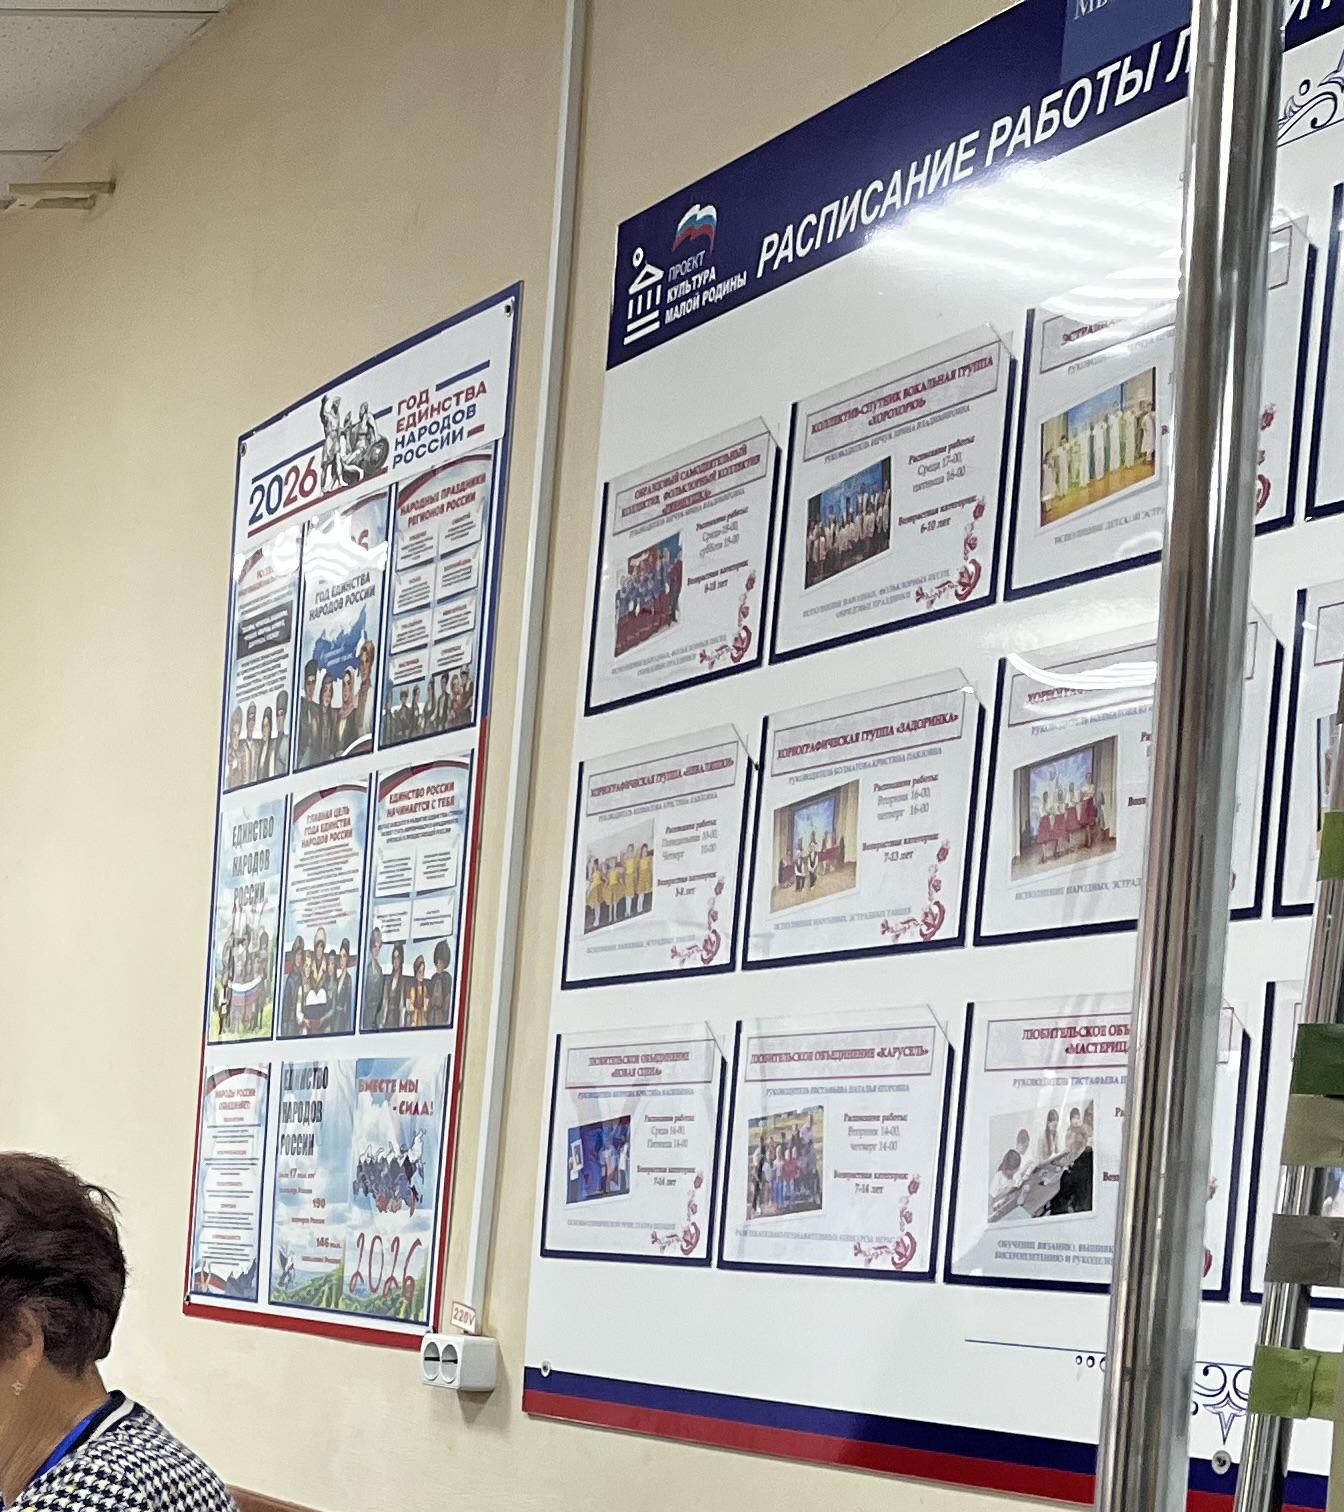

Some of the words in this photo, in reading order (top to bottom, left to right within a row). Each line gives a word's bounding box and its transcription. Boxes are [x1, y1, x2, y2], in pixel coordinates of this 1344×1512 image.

[756, 130, 981, 279] РАСПИСАНИЕ
[984, 41, 1162, 167] РАБОТЫ
[667, 249, 706, 283] ПРОЕКТ
[664, 292, 701, 325] МАЛОЙ
[701, 270, 748, 307] РОДИНЫ
[666, 266, 716, 304] КУЛЬТУРА
[396, 381, 488, 434] ЕДИНСТВА
[397, 388, 430, 416] ГОД
[394, 403, 477, 452] НАРОДОВ
[392, 426, 464, 470] РОССИИ
[248, 455, 319, 526] 2026
[400, 493, 440, 516] НАРОДНЫЕ
[440, 472, 487, 501] ПРАЗДНИКИ
[407, 503, 445, 528] РЕГИОНОВ
[445, 491, 476, 513] РОССИИ
[315, 587, 330, 605] ГОД
[331, 571, 371, 599] ЕДИНСТВА
[308, 596, 344, 622] НАРОДОВ
[345, 585, 376, 606] РОССИИ
[386, 801, 430, 818] НАЧИНАЕТСЯ
[437, 795, 455, 809] ТЕБЯ
[389, 786, 425, 805] ЕДИНСТВО
[425, 781, 455, 796] РОССИИ
[304, 823, 320, 837] ГОДА
[320, 817, 351, 833] ЕДИНСТВА
[306, 809, 333, 824] ГЛАВНАЯ
[333, 805, 351, 818] ЦЕЛЬ
[232, 815, 275, 848] ЕДИНСТВО
[301, 834, 329, 849] НАРОДОВ
[329, 828, 353, 843] РОССИИ
[232, 848, 271, 877] НАРОДОВ
[233, 881, 266, 907] РОССИИ
[1021, 1025, 1107, 1041] ЛЮБИТЕЛЬСКОЕ
[1065, 1041, 1128, 1056] «МАСТЕРИЦ
[283, 1066, 329, 1091] ЕДИНСТВО
[358, 1078, 397, 1093] ВМЕСТЕ
[398, 1078, 419, 1094] МЫ
[281, 1100, 323, 1126] НАРОДОВ
[398, 1101, 434, 1116] СИЛА!
[280, 1133, 315, 1156] РОССИИ
[349, 1232, 423, 1300] 2026
[453, 1307, 475, 1326] 220V
